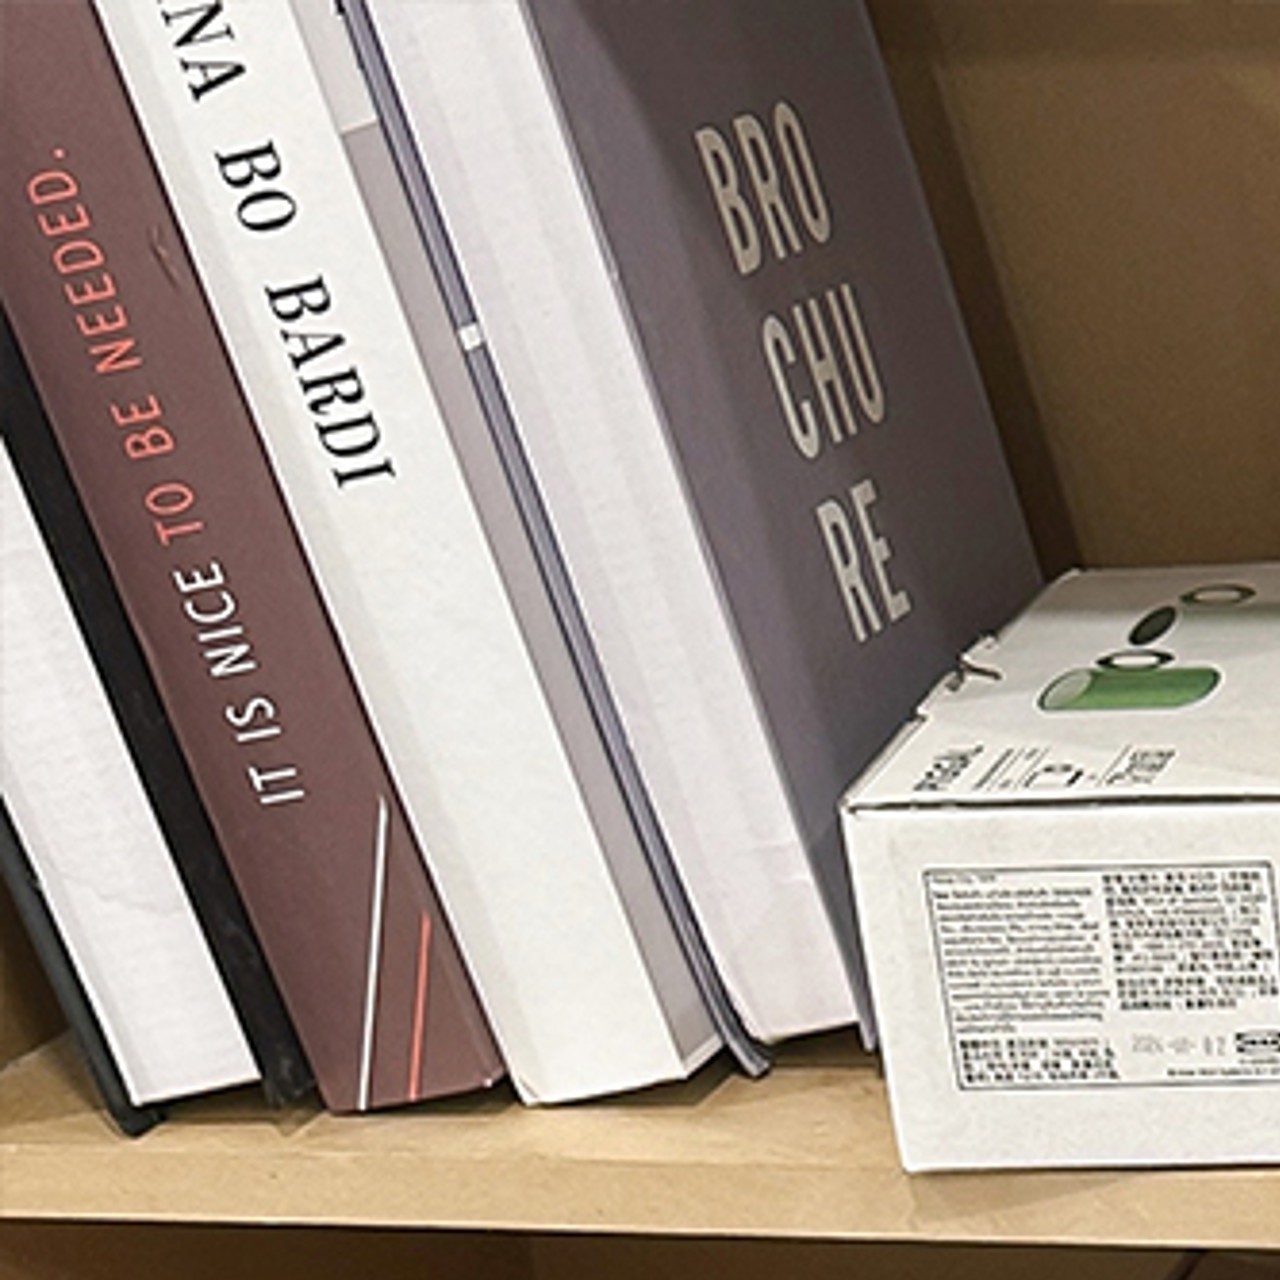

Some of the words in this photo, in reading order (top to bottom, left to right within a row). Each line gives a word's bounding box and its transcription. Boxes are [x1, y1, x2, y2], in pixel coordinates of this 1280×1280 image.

[157, 0, 247, 102] NA
[214, 139, 297, 232] BO
[264, 274, 397, 489] BARDI
[695, 101, 831, 275] BRO
[26, 147, 143, 374] NEEDED.
[109, 394, 176, 460] BE
[762, 283, 886, 460] CHU
[144, 482, 204, 547] TO
[816, 479, 912, 643] RE
[172, 561, 257, 679] NICE
[225, 697, 282, 743] IS
[248, 766, 305, 805] IT
